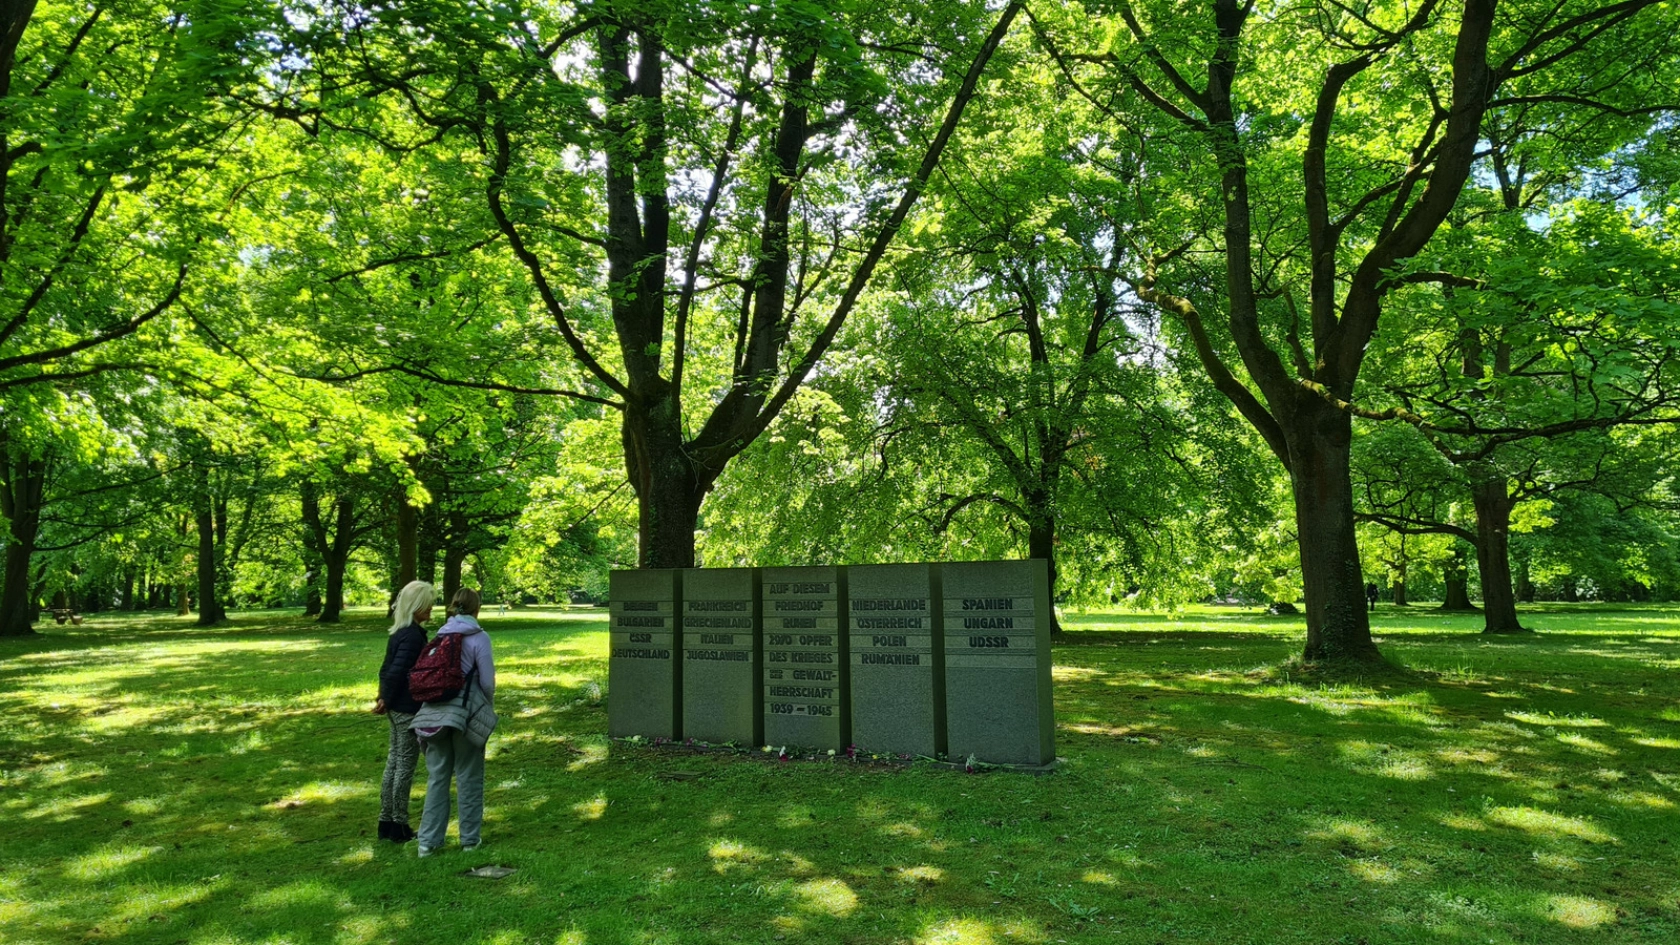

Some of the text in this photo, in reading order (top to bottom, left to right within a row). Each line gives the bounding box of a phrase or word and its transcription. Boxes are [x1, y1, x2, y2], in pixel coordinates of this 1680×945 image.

[769, 583, 830, 594] AUF DIESEM
[688, 601, 746, 611] FRANKREICH
[775, 601, 824, 611] FRIEDHOF
[852, 599, 926, 611] NIEDERLANDE
[962, 598, 1013, 610] SPANIEN
[617, 617, 664, 627] BULGARIEN
[684, 617, 752, 628] GRIECHENLAND
[856, 616, 922, 629] ÖSTERREICH
[964, 617, 1013, 629] UNGARN
[700, 634, 734, 644] ITALIEN
[799, 634, 832, 646] OPFER
[872, 635, 907, 647] POLEN
[969, 636, 1009, 648] UDSSR
[611, 649, 670, 659] DEUTSCHLAND
[687, 650, 749, 661] JUGOSLAWIEN
[769, 651, 833, 663] DES KRIEGES
[861, 653, 920, 665] RUMÄNIEN
[793, 670, 837, 681] GEWALT-
[770, 686, 834, 698] HERRSCHAFT
[770, 703, 794, 714] 1939
[807, 705, 832, 716] 1945
